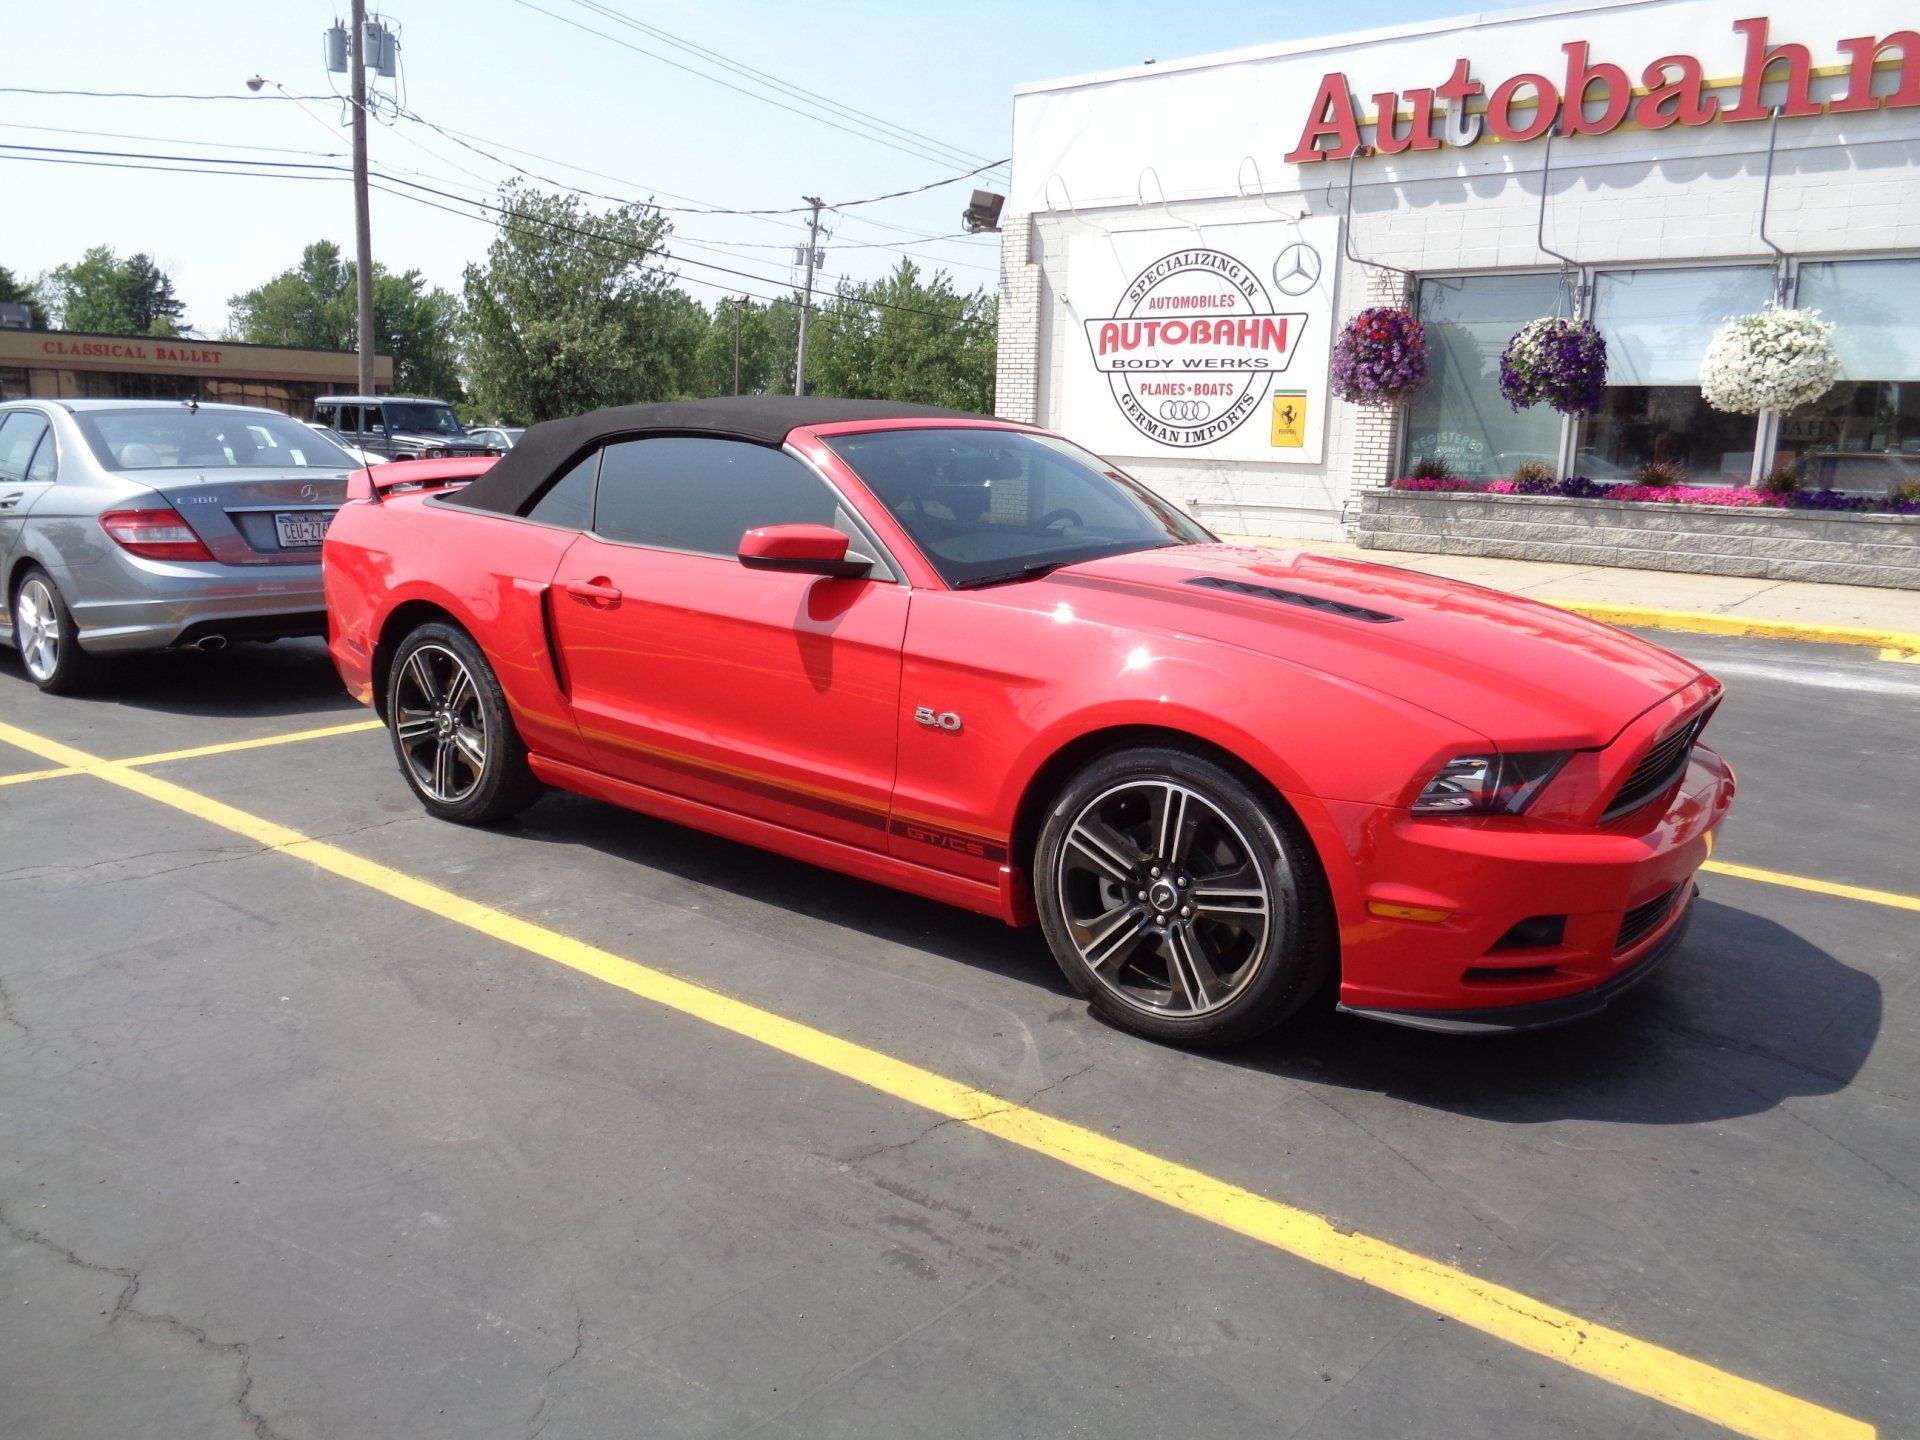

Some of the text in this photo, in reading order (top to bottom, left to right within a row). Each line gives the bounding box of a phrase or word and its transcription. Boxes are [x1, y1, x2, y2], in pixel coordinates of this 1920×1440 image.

[1284, 17, 1920, 164] Autobahn
[1130, 253, 1258, 303] SPECIALIZING IN
[1148, 294, 1235, 310] AUTOMOBILES
[1099, 318, 1288, 355] AUTOBAHN
[42, 341, 222, 364] CLASSICAL BALLET
[1112, 358, 1269, 369] BODY WERKS
[1121, 393, 1255, 443] GERMAN IMPORTS
[1411, 432, 1484, 453] REGISTERED
[914, 706, 962, 731] 5.0
[906, 826, 985, 857] GT/CS
